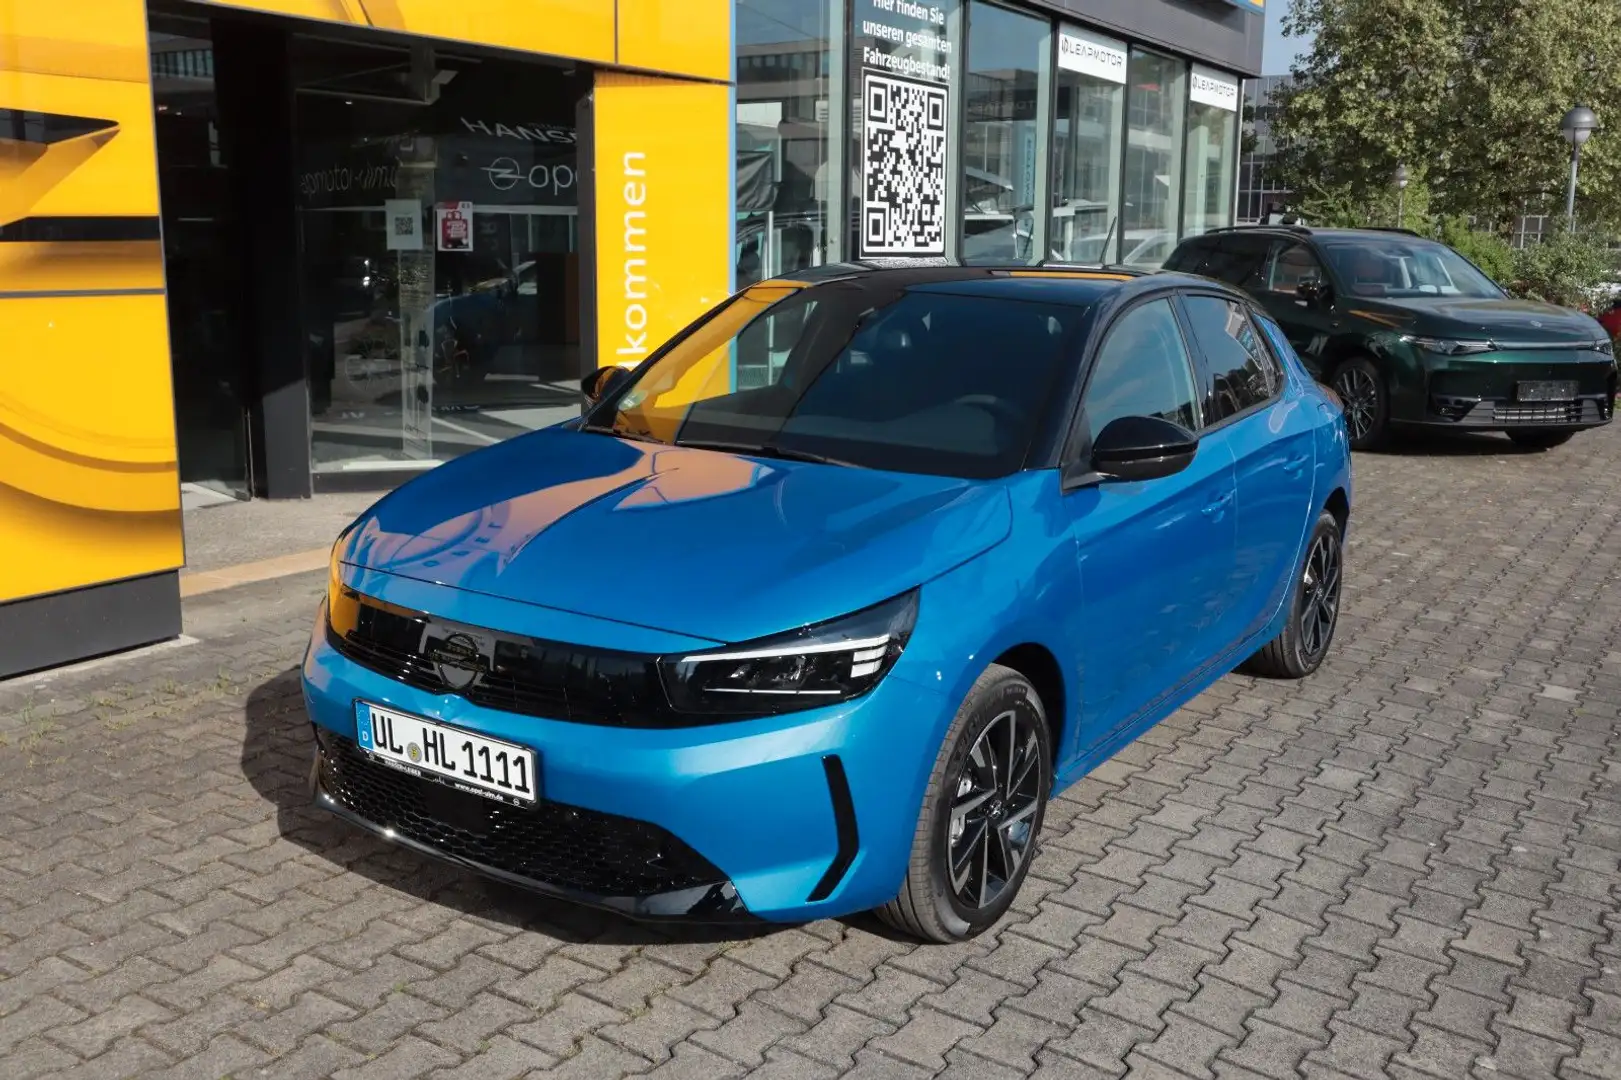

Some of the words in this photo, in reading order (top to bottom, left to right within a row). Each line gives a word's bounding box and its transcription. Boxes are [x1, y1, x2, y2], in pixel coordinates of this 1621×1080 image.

[896, 0, 928, 21] finden
[930, 6, 945, 25] Sie
[862, 20, 904, 42] unseren
[905, 31, 952, 53] gesamten
[863, 46, 951, 80] Fahrzeugbestand!
[1069, 43, 1123, 67] LEAPMOTOR
[1197, 77, 1236, 98] LEAPMOTOR
[362, 731, 369, 742] D
[371, 713, 404, 754] UL
[422, 727, 456, 771] HL
[461, 740, 530, 794] 1111
